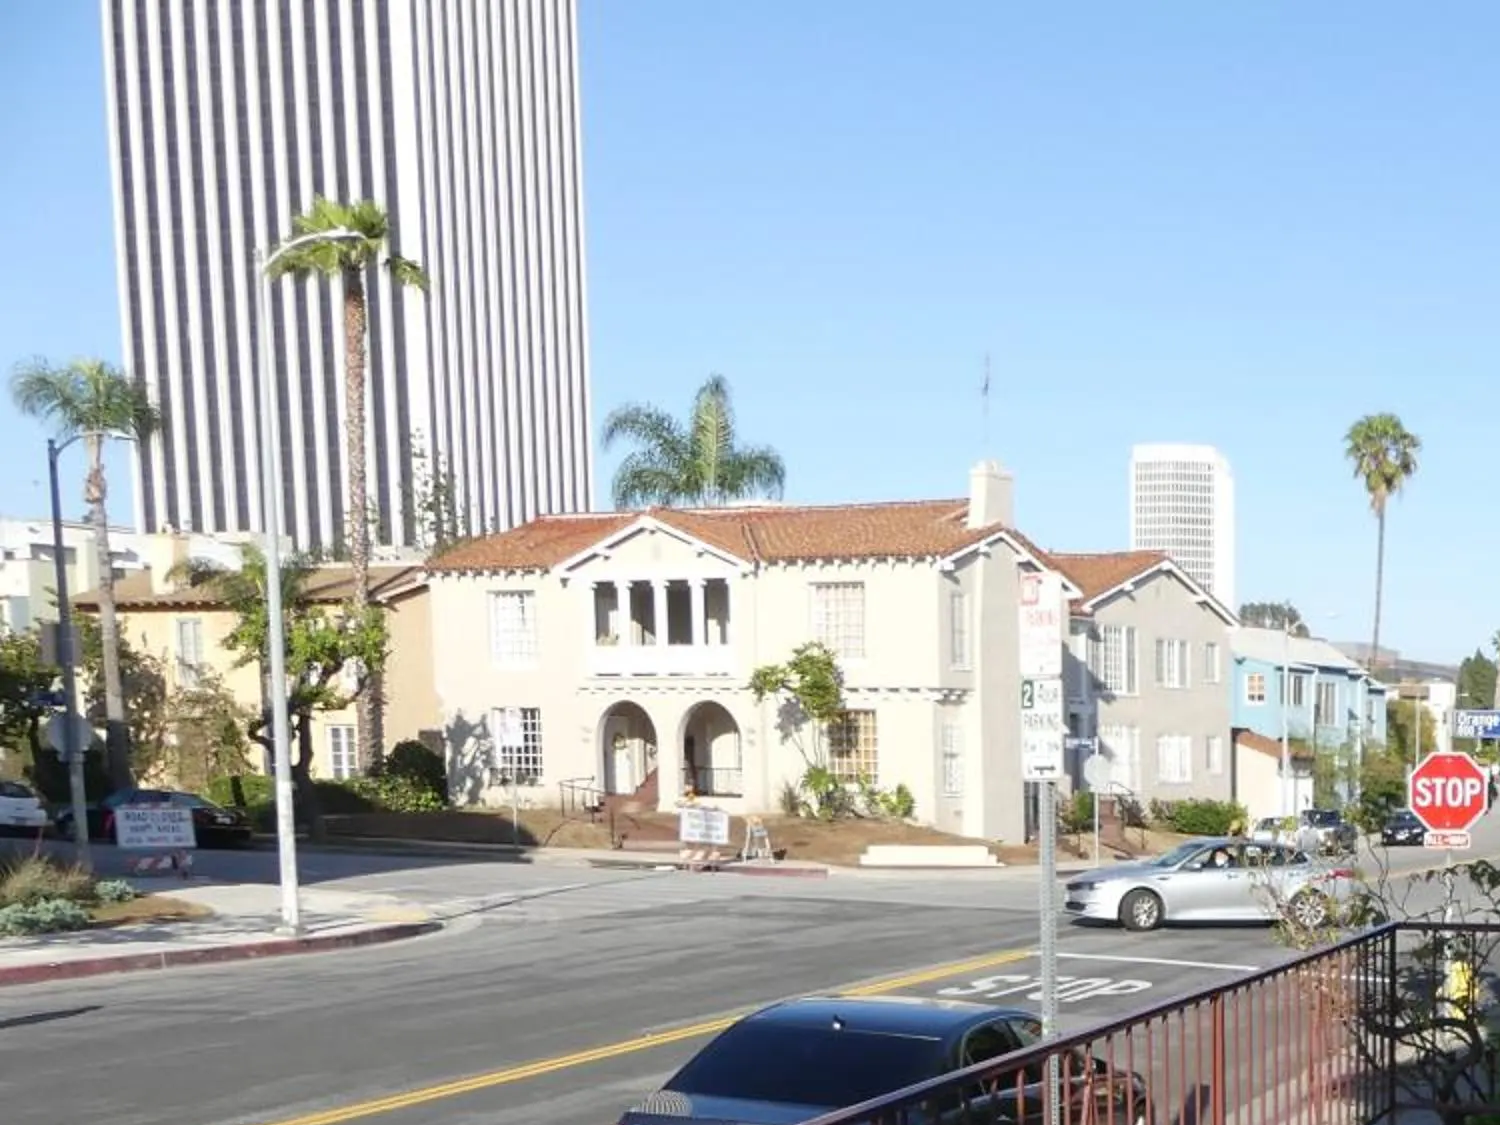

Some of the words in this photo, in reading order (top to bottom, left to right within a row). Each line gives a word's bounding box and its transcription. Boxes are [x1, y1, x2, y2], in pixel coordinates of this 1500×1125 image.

[1023, 683, 1032, 708] 2
[1023, 712, 1060, 731] PARKING
[1459, 711, 1500, 731] Orange
[1415, 776, 1481, 808] STOP
[936, 975, 1153, 1002] STOP
